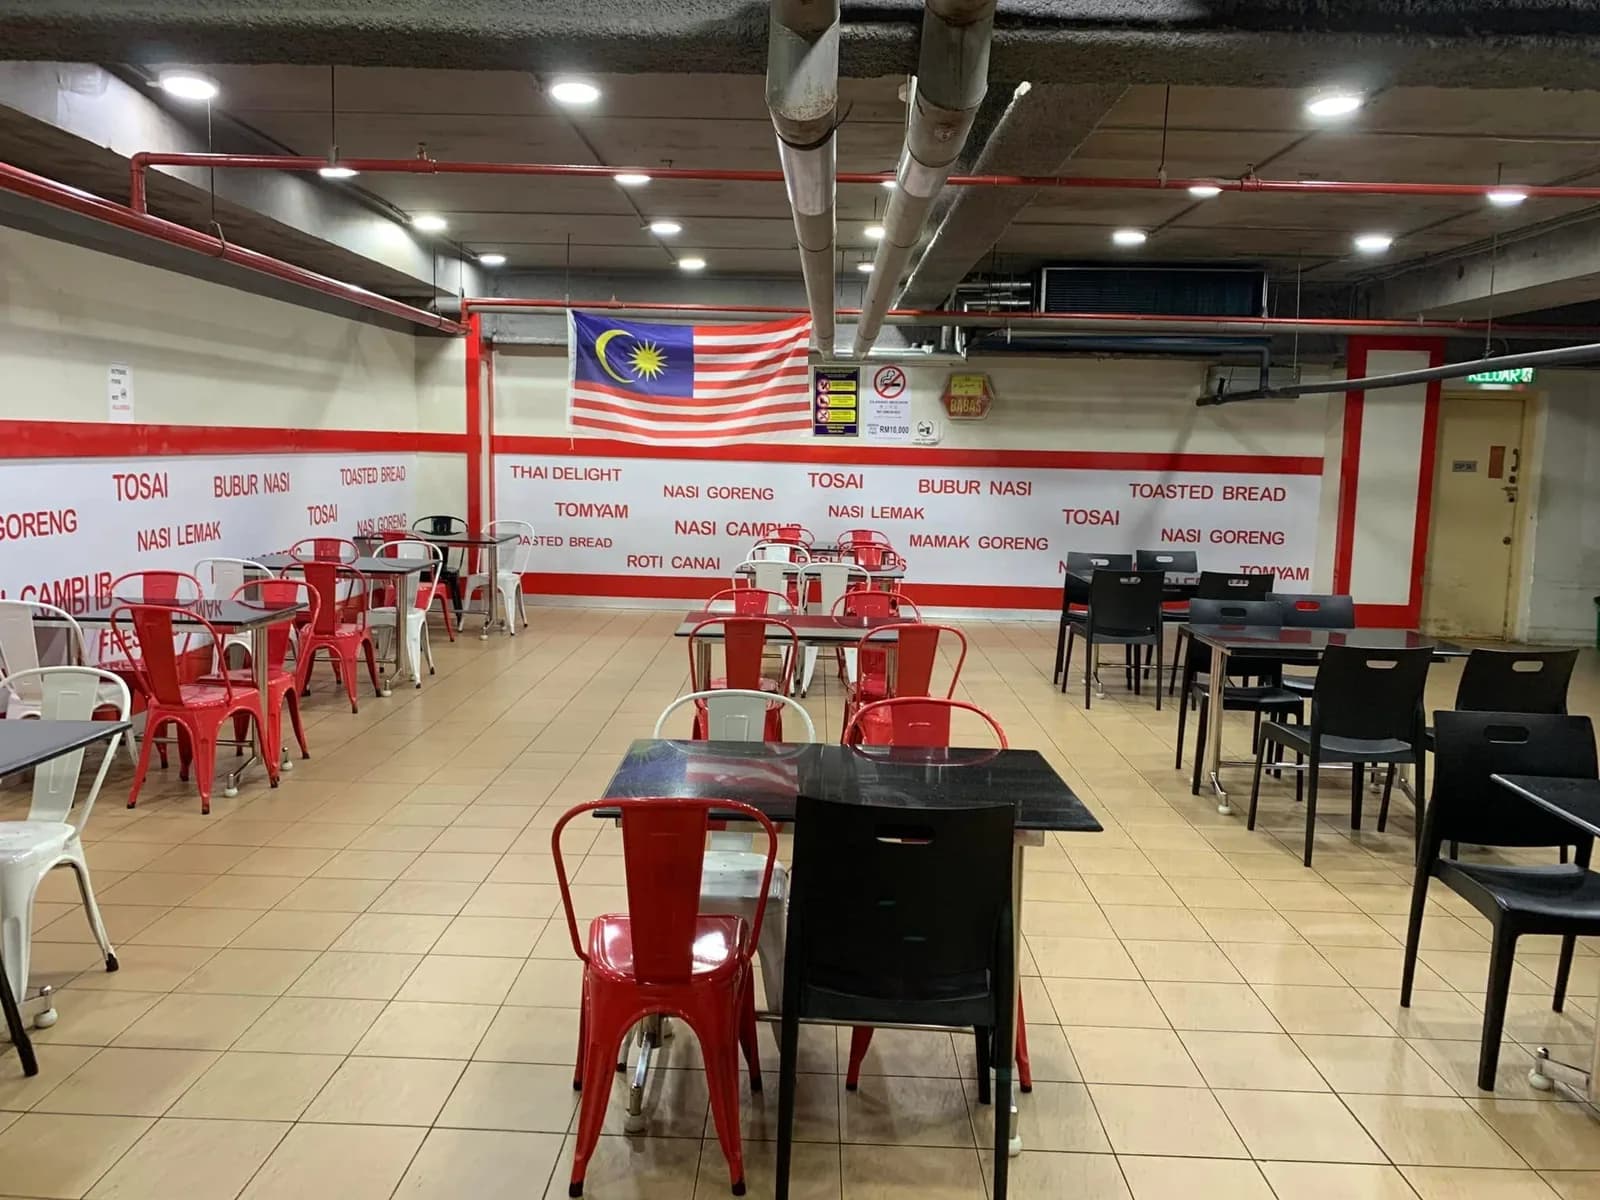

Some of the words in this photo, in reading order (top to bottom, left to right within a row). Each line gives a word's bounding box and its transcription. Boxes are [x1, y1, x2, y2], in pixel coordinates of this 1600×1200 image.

[340, 468, 379, 486] TOASTED
[380, 465, 406, 483] BREAD
[510, 465, 549, 480] THAI
[552, 467, 622, 482] DELIGHT
[808, 472, 864, 489] TOSAI
[112, 472, 169, 501] TOSAI
[213, 474, 258, 497] BUBUR
[263, 471, 290, 494] NASI
[663, 484, 699, 498] NASI
[705, 485, 775, 500] GORENG
[918, 478, 982, 496] BUBUR
[989, 480, 1033, 497] NASI
[1129, 483, 1214, 501] TOASTED
[1222, 485, 1287, 502] BREAD
[307, 503, 339, 525] TOSAI
[555, 502, 629, 519] TOMYAM
[828, 504, 864, 519] NASI
[871, 505, 925, 520] LEMAK
[1062, 508, 1120, 526] TOSAI
[357, 519, 375, 537] NASI
[377, 513, 407, 530] GORENG
[674, 520, 715, 535] NASI
[137, 526, 171, 552] NASI
[176, 521, 221, 546] LEMAK
[517, 535, 564, 548] OASTED
[568, 536, 613, 548] BREAD
[909, 533, 971, 549] MAMAK
[977, 535, 1049, 551] GORENG
[1160, 527, 1203, 543] NASI
[1209, 529, 1286, 546] GORENG
[627, 554, 664, 569] ROTI
[670, 556, 719, 570] CANAI
[1239, 563, 1310, 581] TOMYAM
[99, 628, 141, 655] FRES
